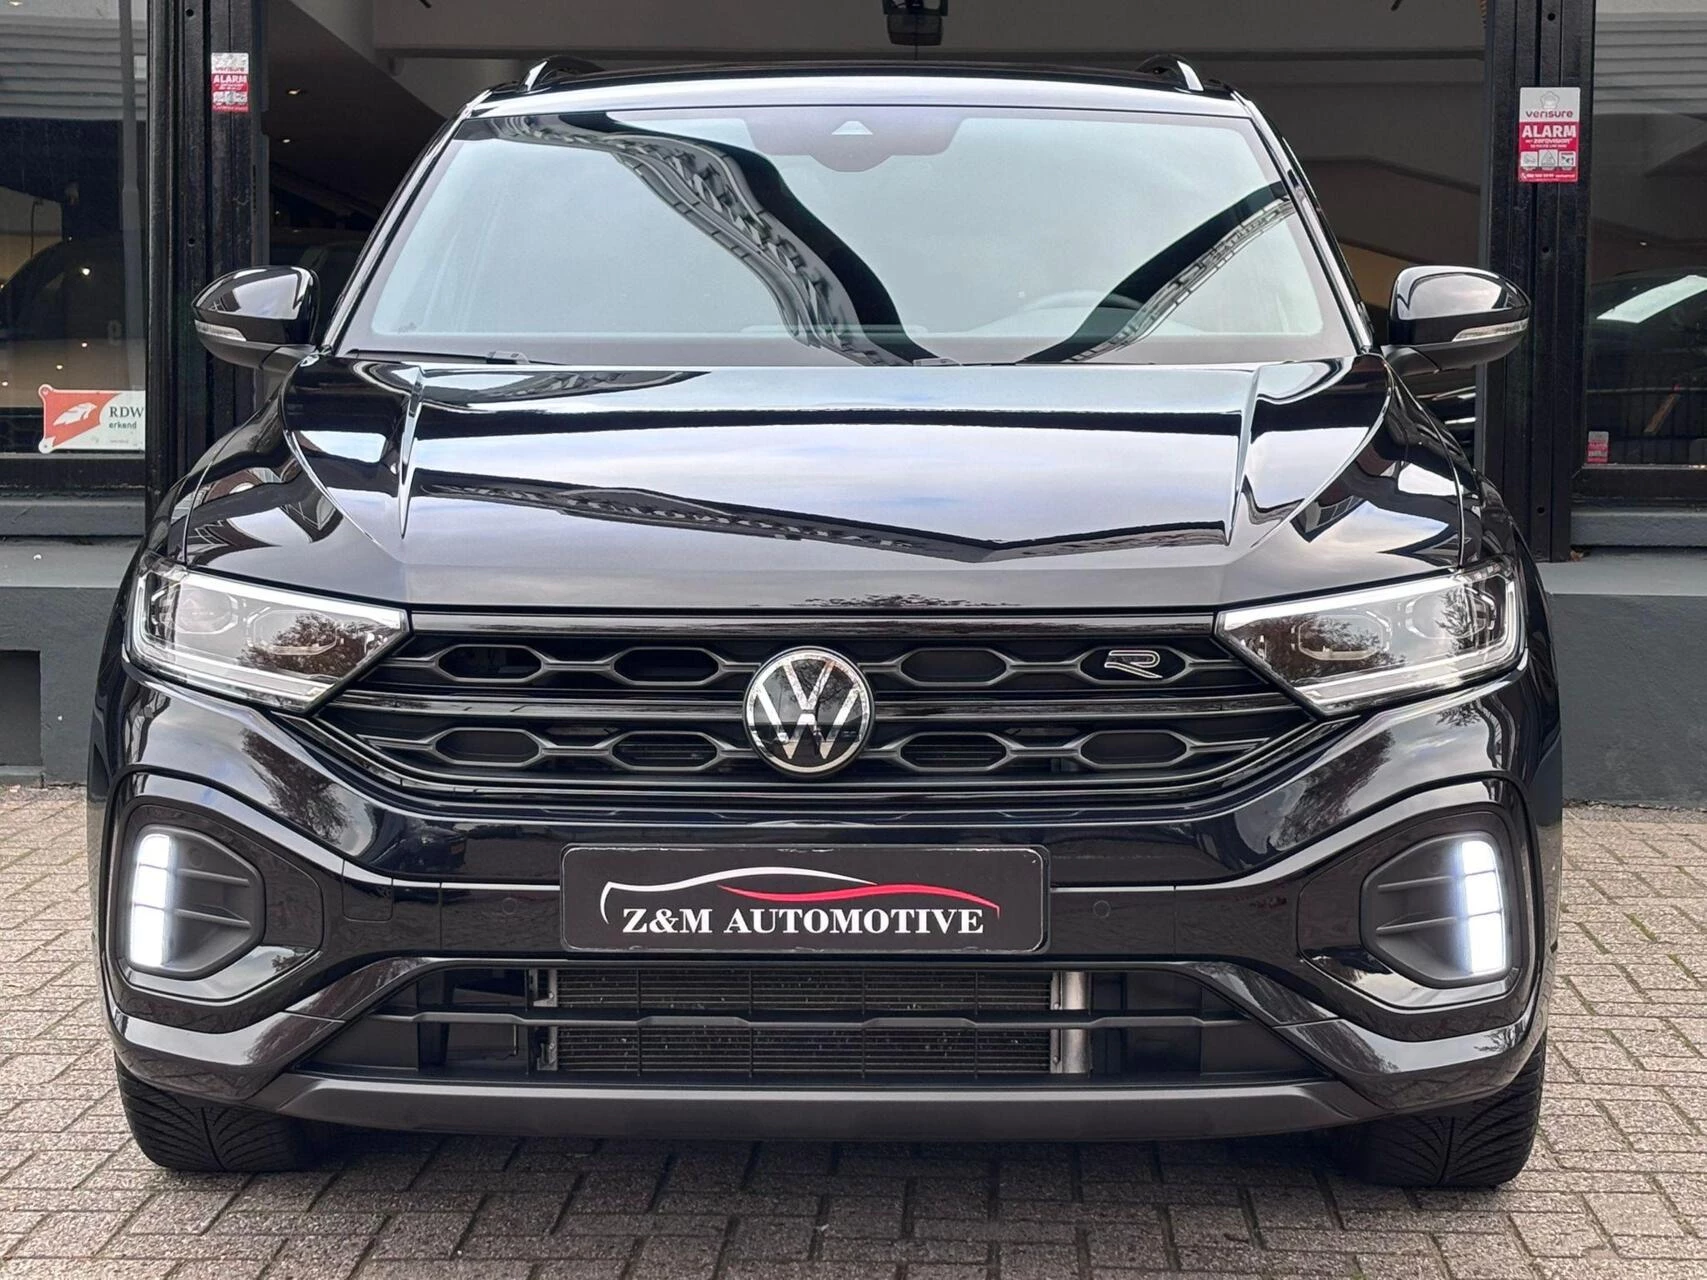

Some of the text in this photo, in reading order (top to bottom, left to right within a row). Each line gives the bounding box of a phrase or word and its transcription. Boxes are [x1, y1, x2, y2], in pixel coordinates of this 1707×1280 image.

[213, 74, 248, 84] ALARM
[1525, 110, 1574, 118] verisure
[1521, 125, 1577, 138] ALARM
[109, 406, 144, 418] RDW
[109, 421, 137, 429] erkend
[622, 908, 984, 935] Z&M AUTOMOTIVE
